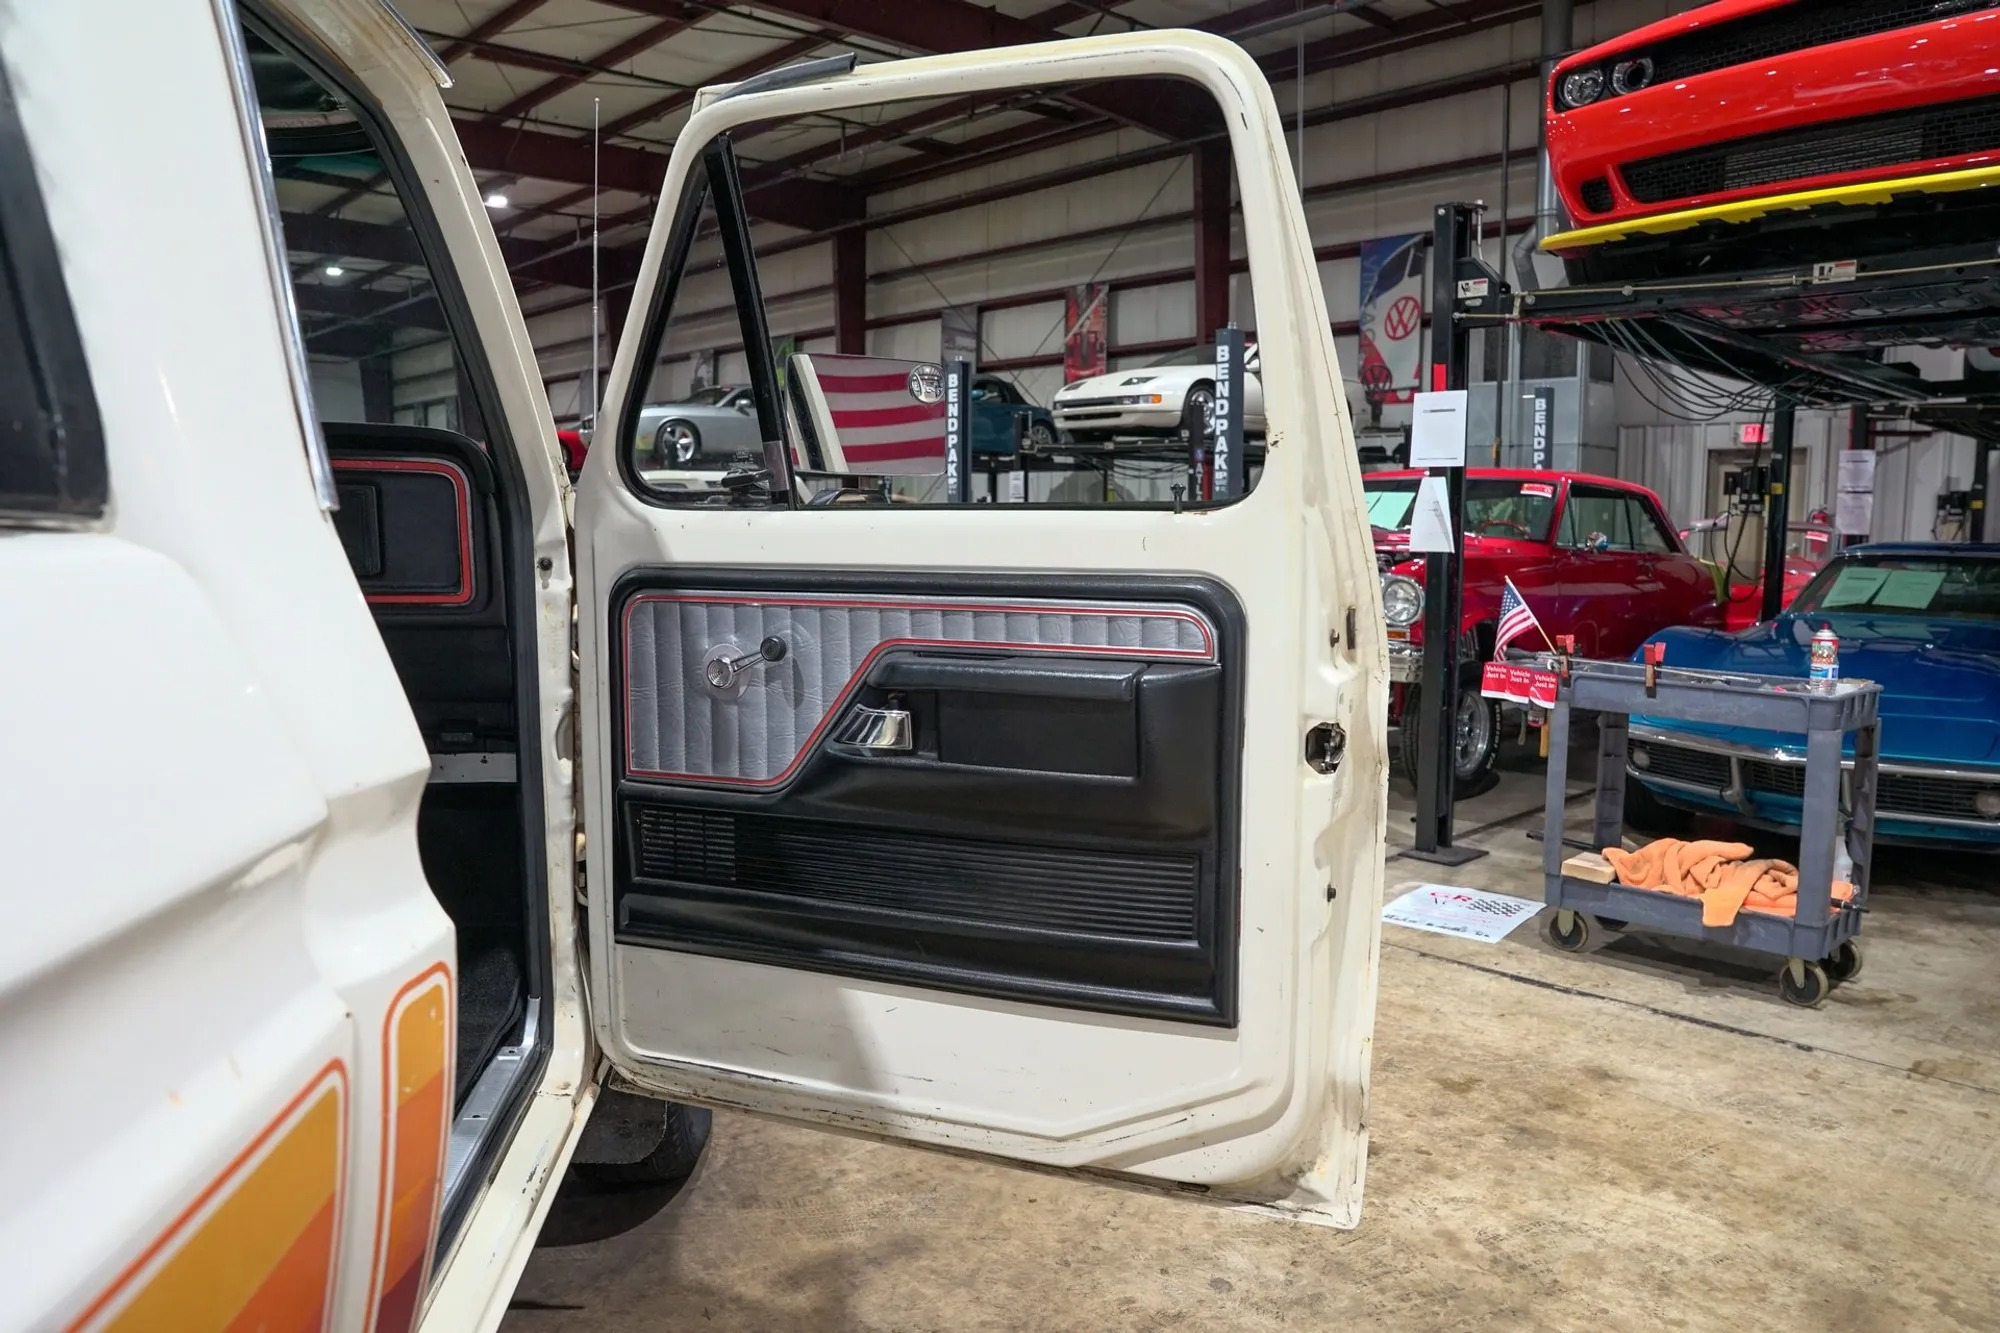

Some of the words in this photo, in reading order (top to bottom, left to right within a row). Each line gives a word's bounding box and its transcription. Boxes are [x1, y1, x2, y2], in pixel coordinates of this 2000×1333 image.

[1214, 345, 1230, 470] BENDPAK
[947, 373, 958, 477] BENDPAK
[1486, 665, 1507, 673] Vehicle
[1510, 669, 1531, 677] Vehicle
[1534, 674, 1556, 682] Vehicle
